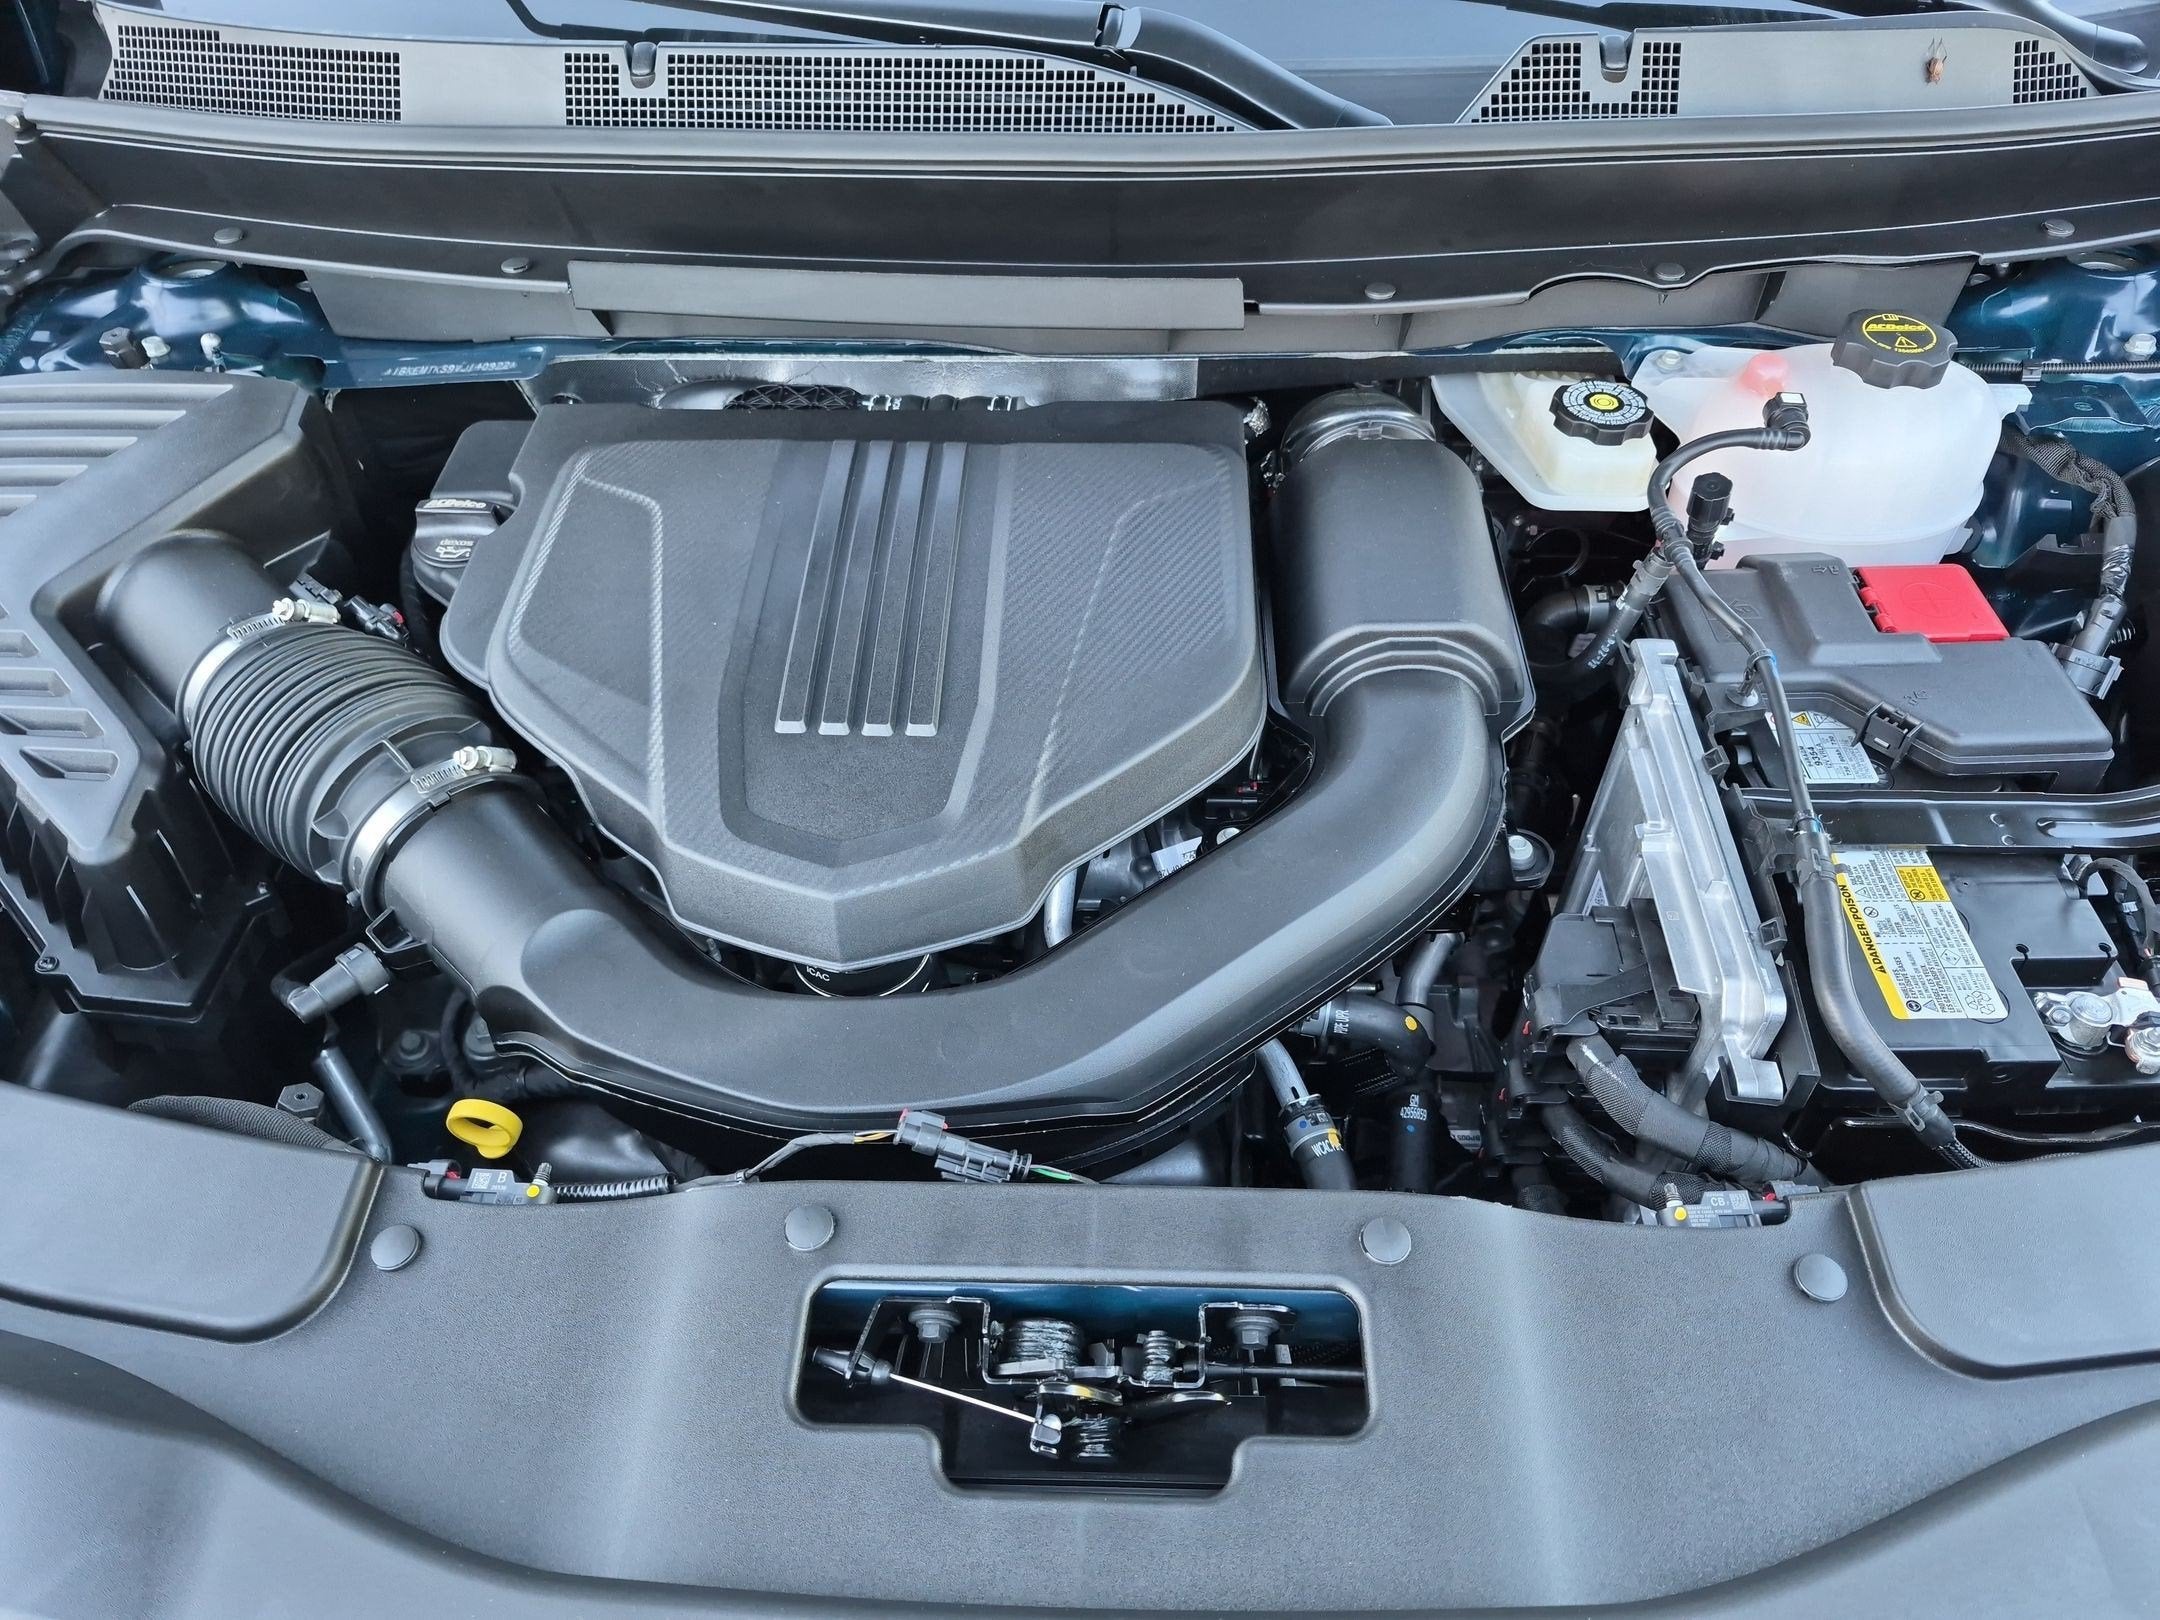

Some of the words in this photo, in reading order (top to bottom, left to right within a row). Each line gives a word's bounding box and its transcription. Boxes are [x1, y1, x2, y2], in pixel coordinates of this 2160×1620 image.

[1866, 323, 1927, 331] ACDelco
[1806, 746, 1823, 766] 9354
[1836, 884, 1884, 964] DANGER/POISON
[1410, 1094, 1420, 1107] GM
[497, 1171, 508, 1183] B
[1710, 1197, 1726, 1207] CB
